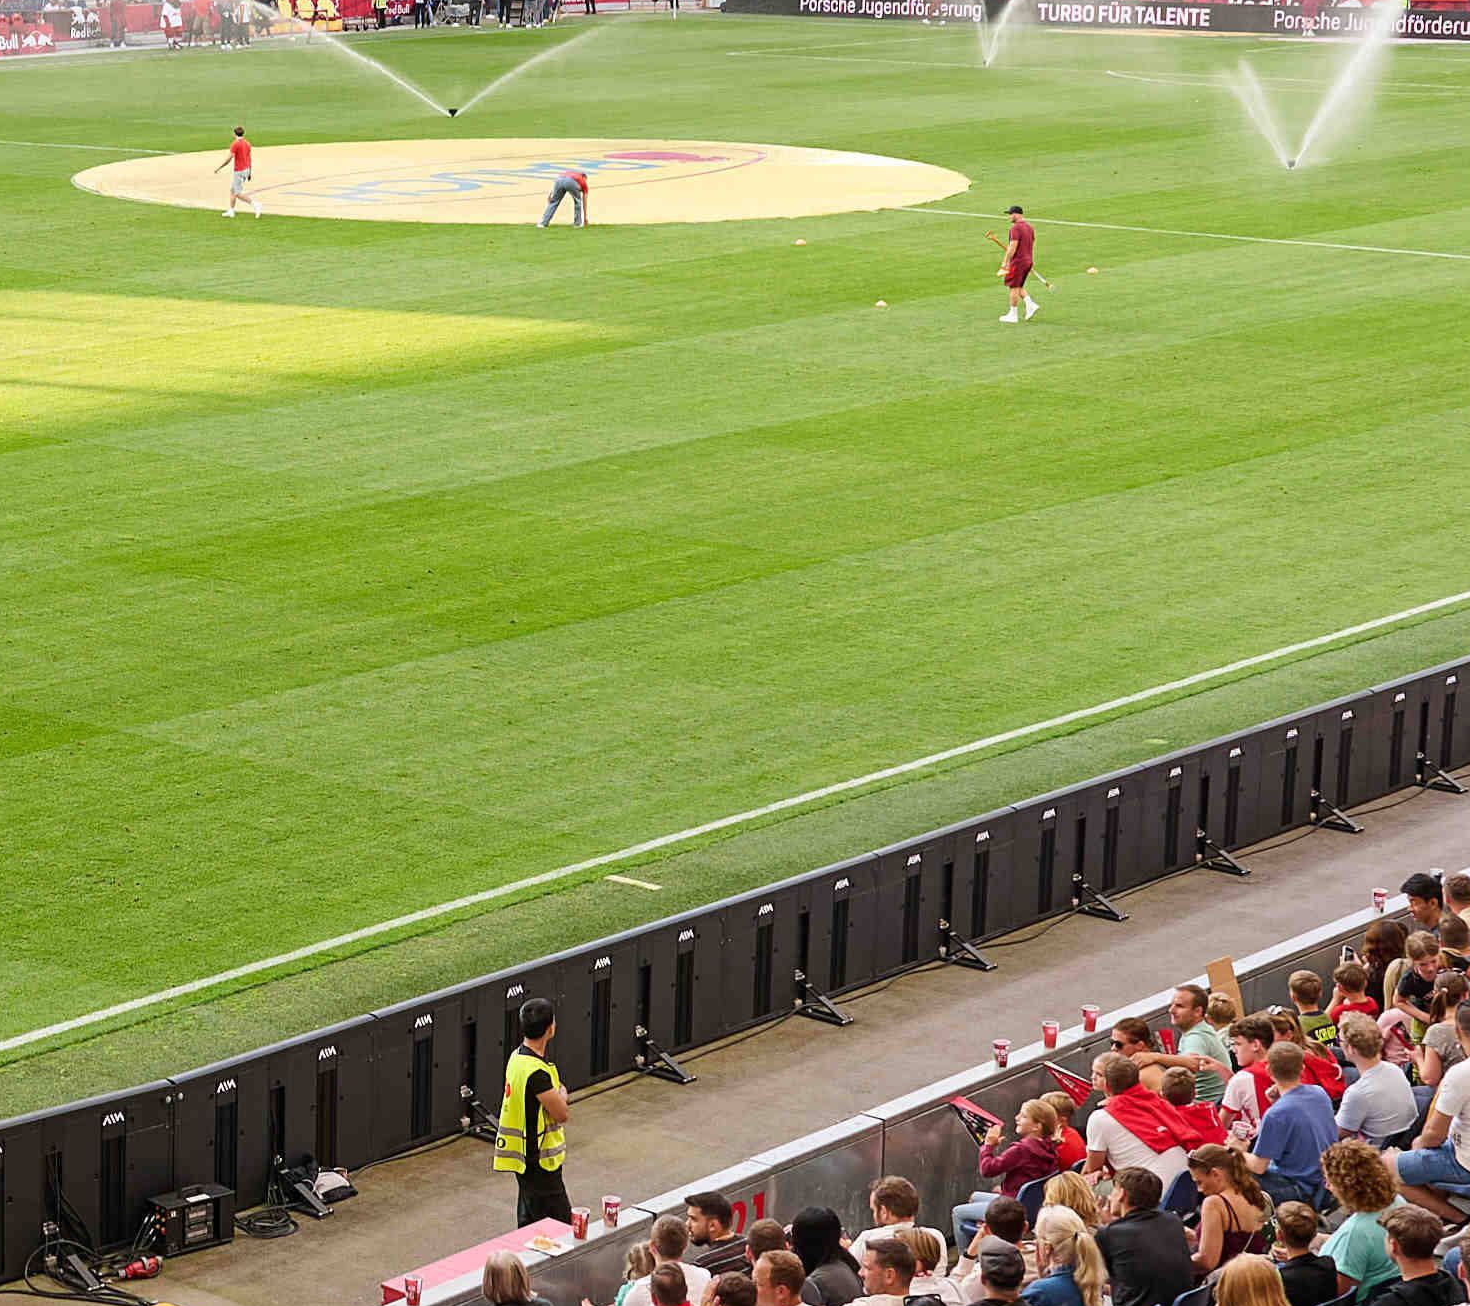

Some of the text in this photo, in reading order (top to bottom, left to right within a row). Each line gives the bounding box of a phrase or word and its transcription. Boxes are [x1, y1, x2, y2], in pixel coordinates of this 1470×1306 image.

[1038, 0, 1211, 28] TURBO FÜR TALENTE
[0, 34, 19, 52] Bull
